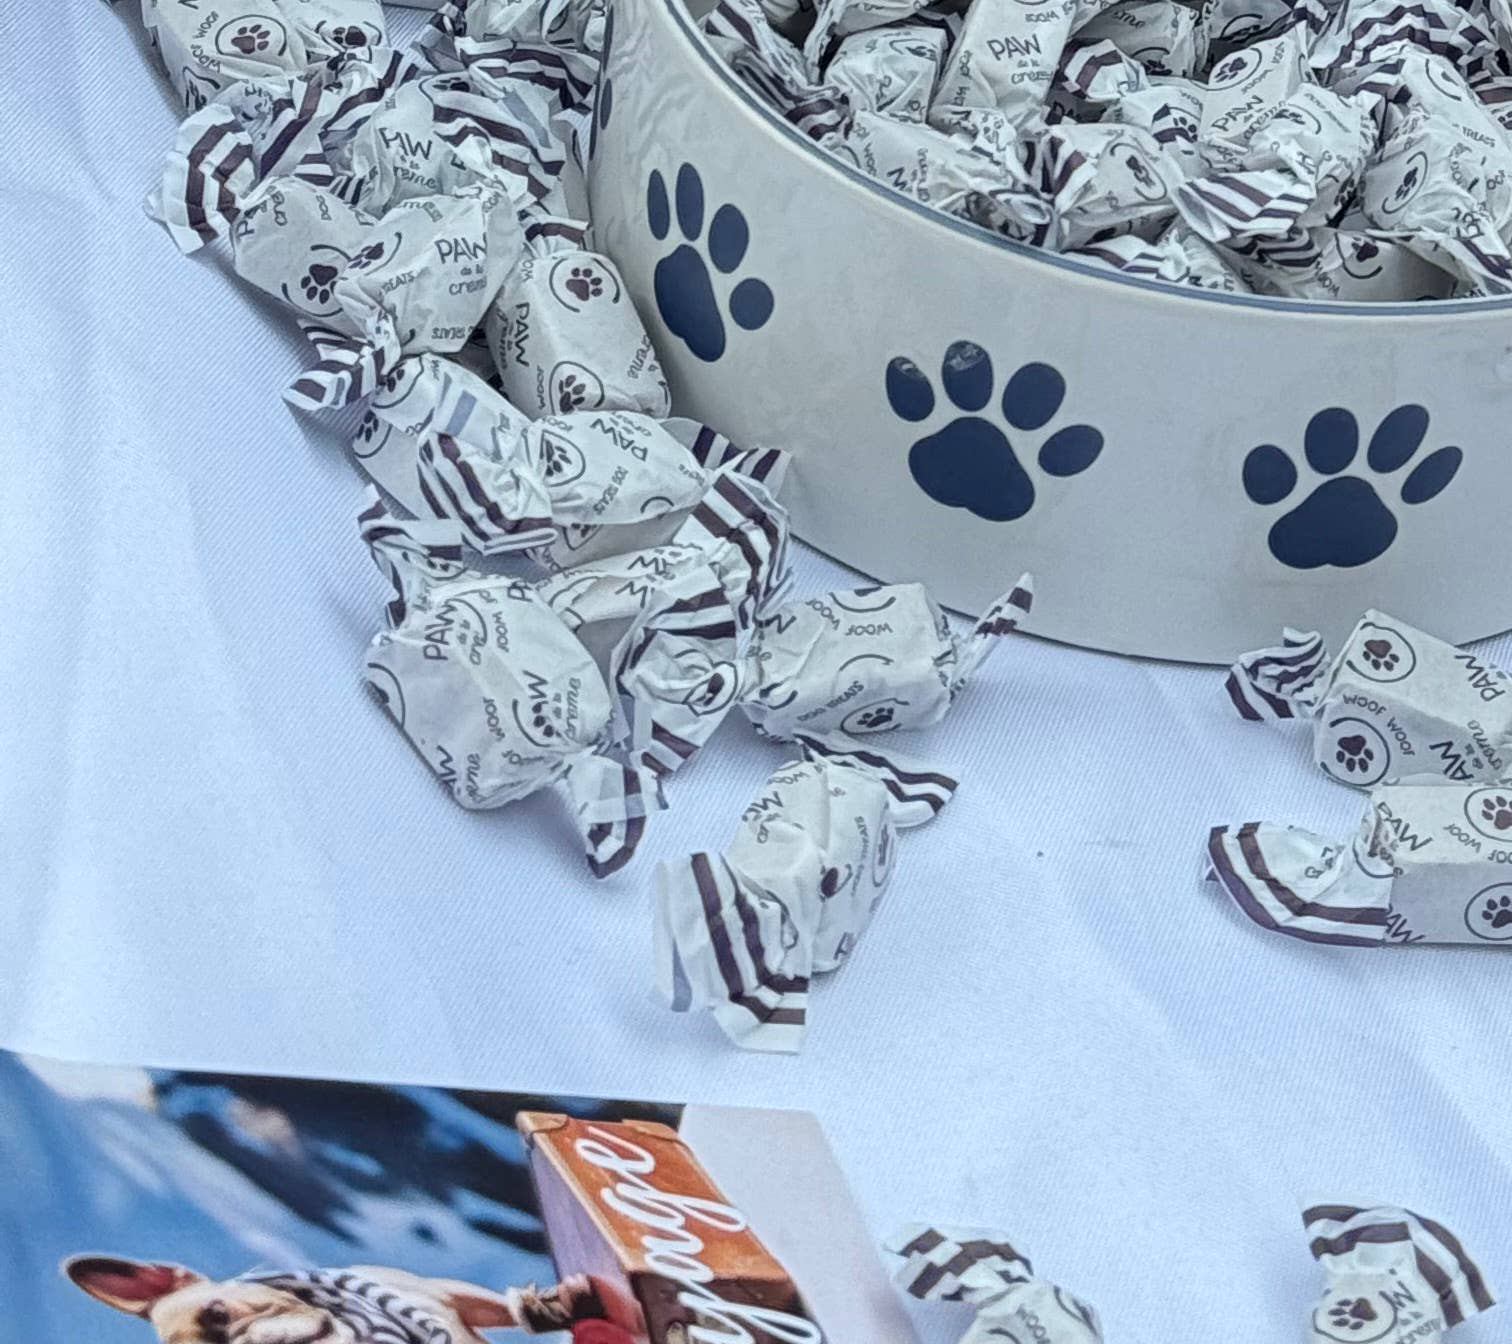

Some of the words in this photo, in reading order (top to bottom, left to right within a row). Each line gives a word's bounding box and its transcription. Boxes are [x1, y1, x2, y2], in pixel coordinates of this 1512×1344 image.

[986, 33, 1042, 62] PAW
[392, 165, 437, 188] reme
[436, 234, 489, 264] PAW
[514, 301, 531, 367] PAW
[590, 417, 649, 462] PAW
[423, 601, 458, 661] PAW
[805, 597, 841, 631] WOOF
[844, 622, 894, 637] WOOF
[1454, 653, 1507, 703] PAW
[1341, 692, 1387, 716] WOOF
[1386, 716, 1416, 758] WOOF
[1466, 719, 1505, 772] creme
[435, 745, 457, 787] AW
[1428, 740, 1475, 783] AW
[1376, 801, 1434, 853] PAW
[1443, 822, 1483, 854] WOOF
[1384, 911, 1426, 944] AW
